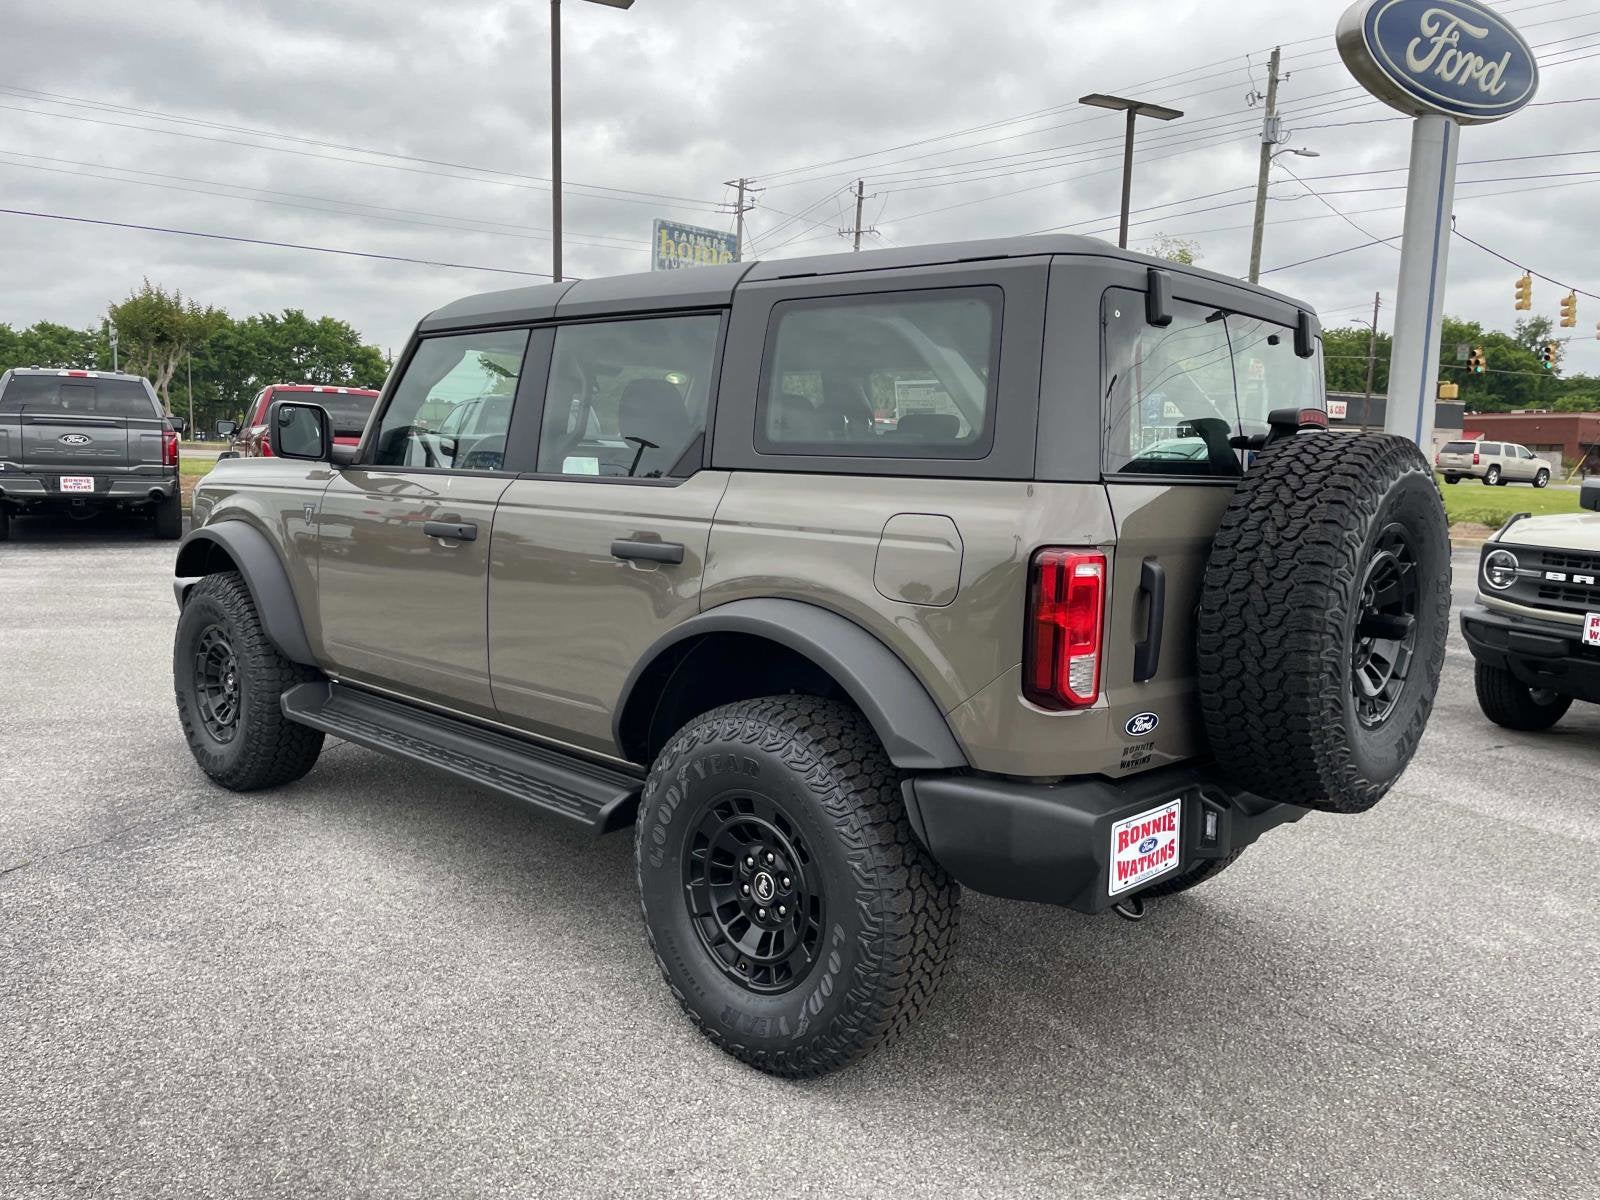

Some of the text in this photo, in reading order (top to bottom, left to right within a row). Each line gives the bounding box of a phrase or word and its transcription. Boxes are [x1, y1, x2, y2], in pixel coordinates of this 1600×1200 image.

[1406, 8, 1512, 97] Ford
[674, 230, 726, 251] FARMERS
[1132, 715, 1154, 732] Ford
[1122, 742, 1154, 757] RONNIE
[1120, 754, 1152, 769] WATKINS
[1117, 810, 1176, 854] RONNIE
[1141, 838, 1156, 853] Ford
[1117, 838, 1176, 882] WATKINS
